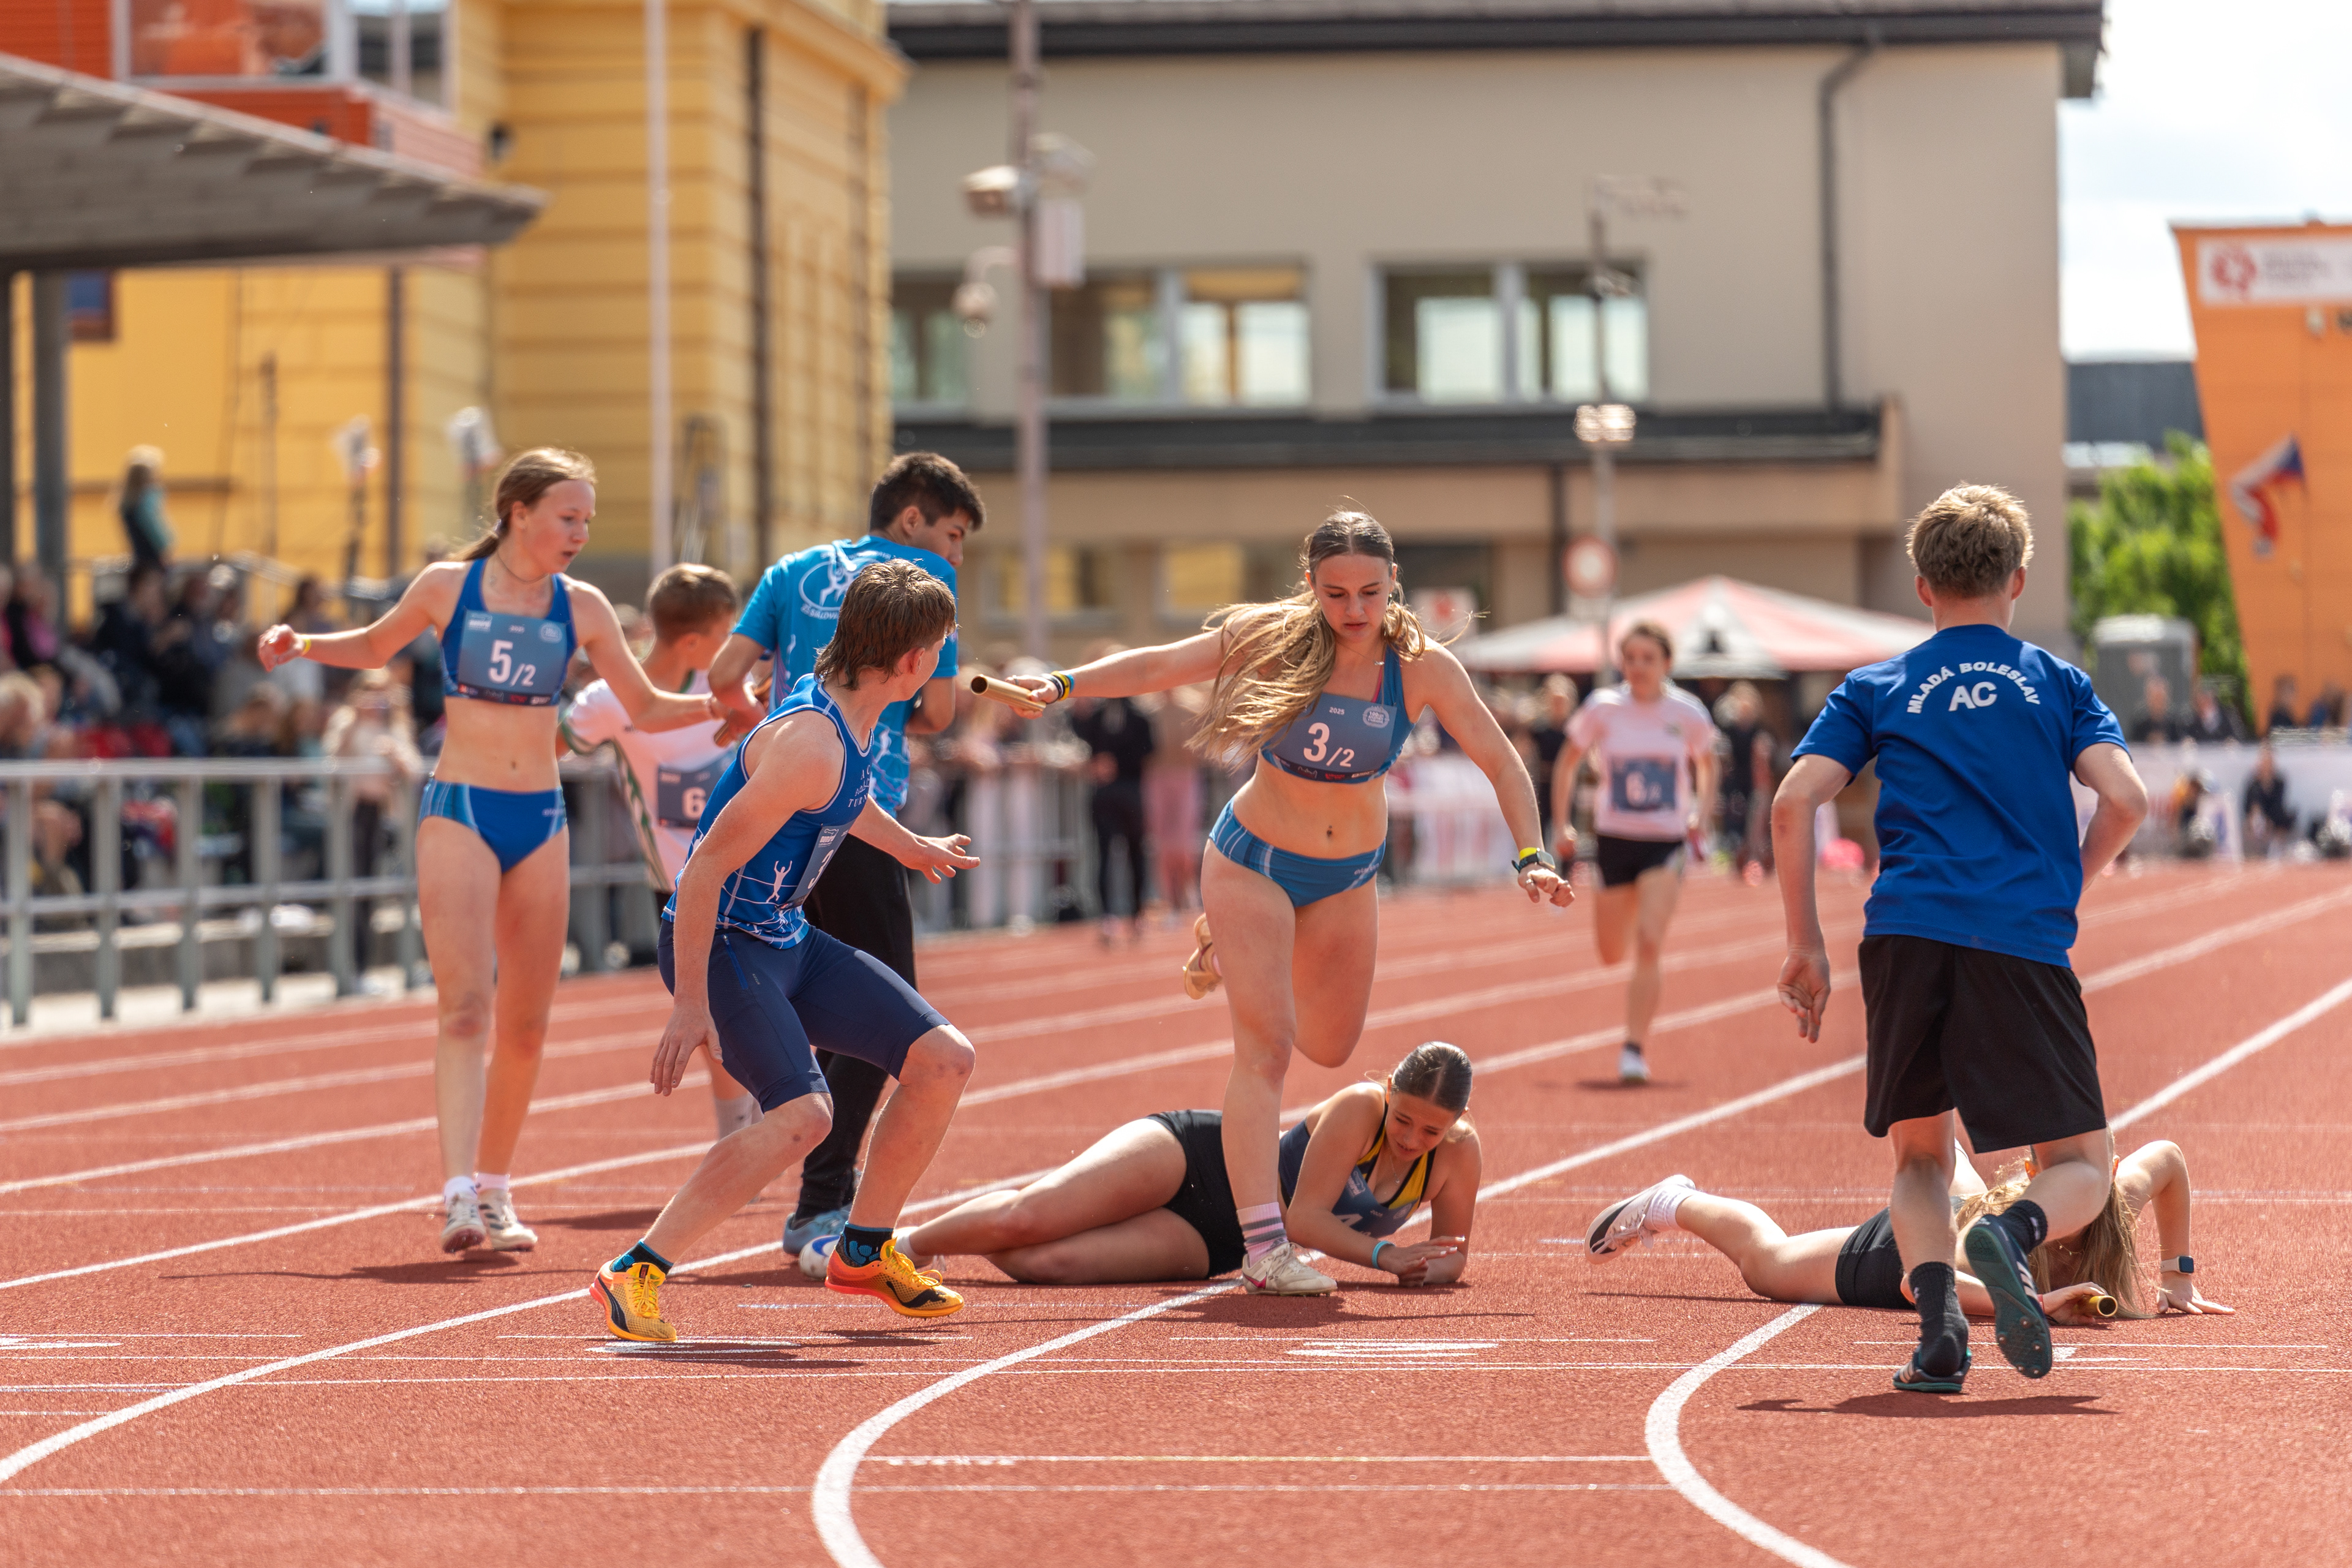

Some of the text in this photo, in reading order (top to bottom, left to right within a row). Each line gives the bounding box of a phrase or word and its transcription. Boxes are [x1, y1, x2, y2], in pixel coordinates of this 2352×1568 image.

[488, 639, 536, 687] 5/2
[1907, 662, 2040, 714] MLADÁ BOLESLAV
[1948, 682, 1997, 712] AC
[1329, 707, 1345, 715] 2025
[1303, 722, 1354, 767] 3/2
[682, 786, 707, 820] 6
[808, 850, 834, 889] 3
